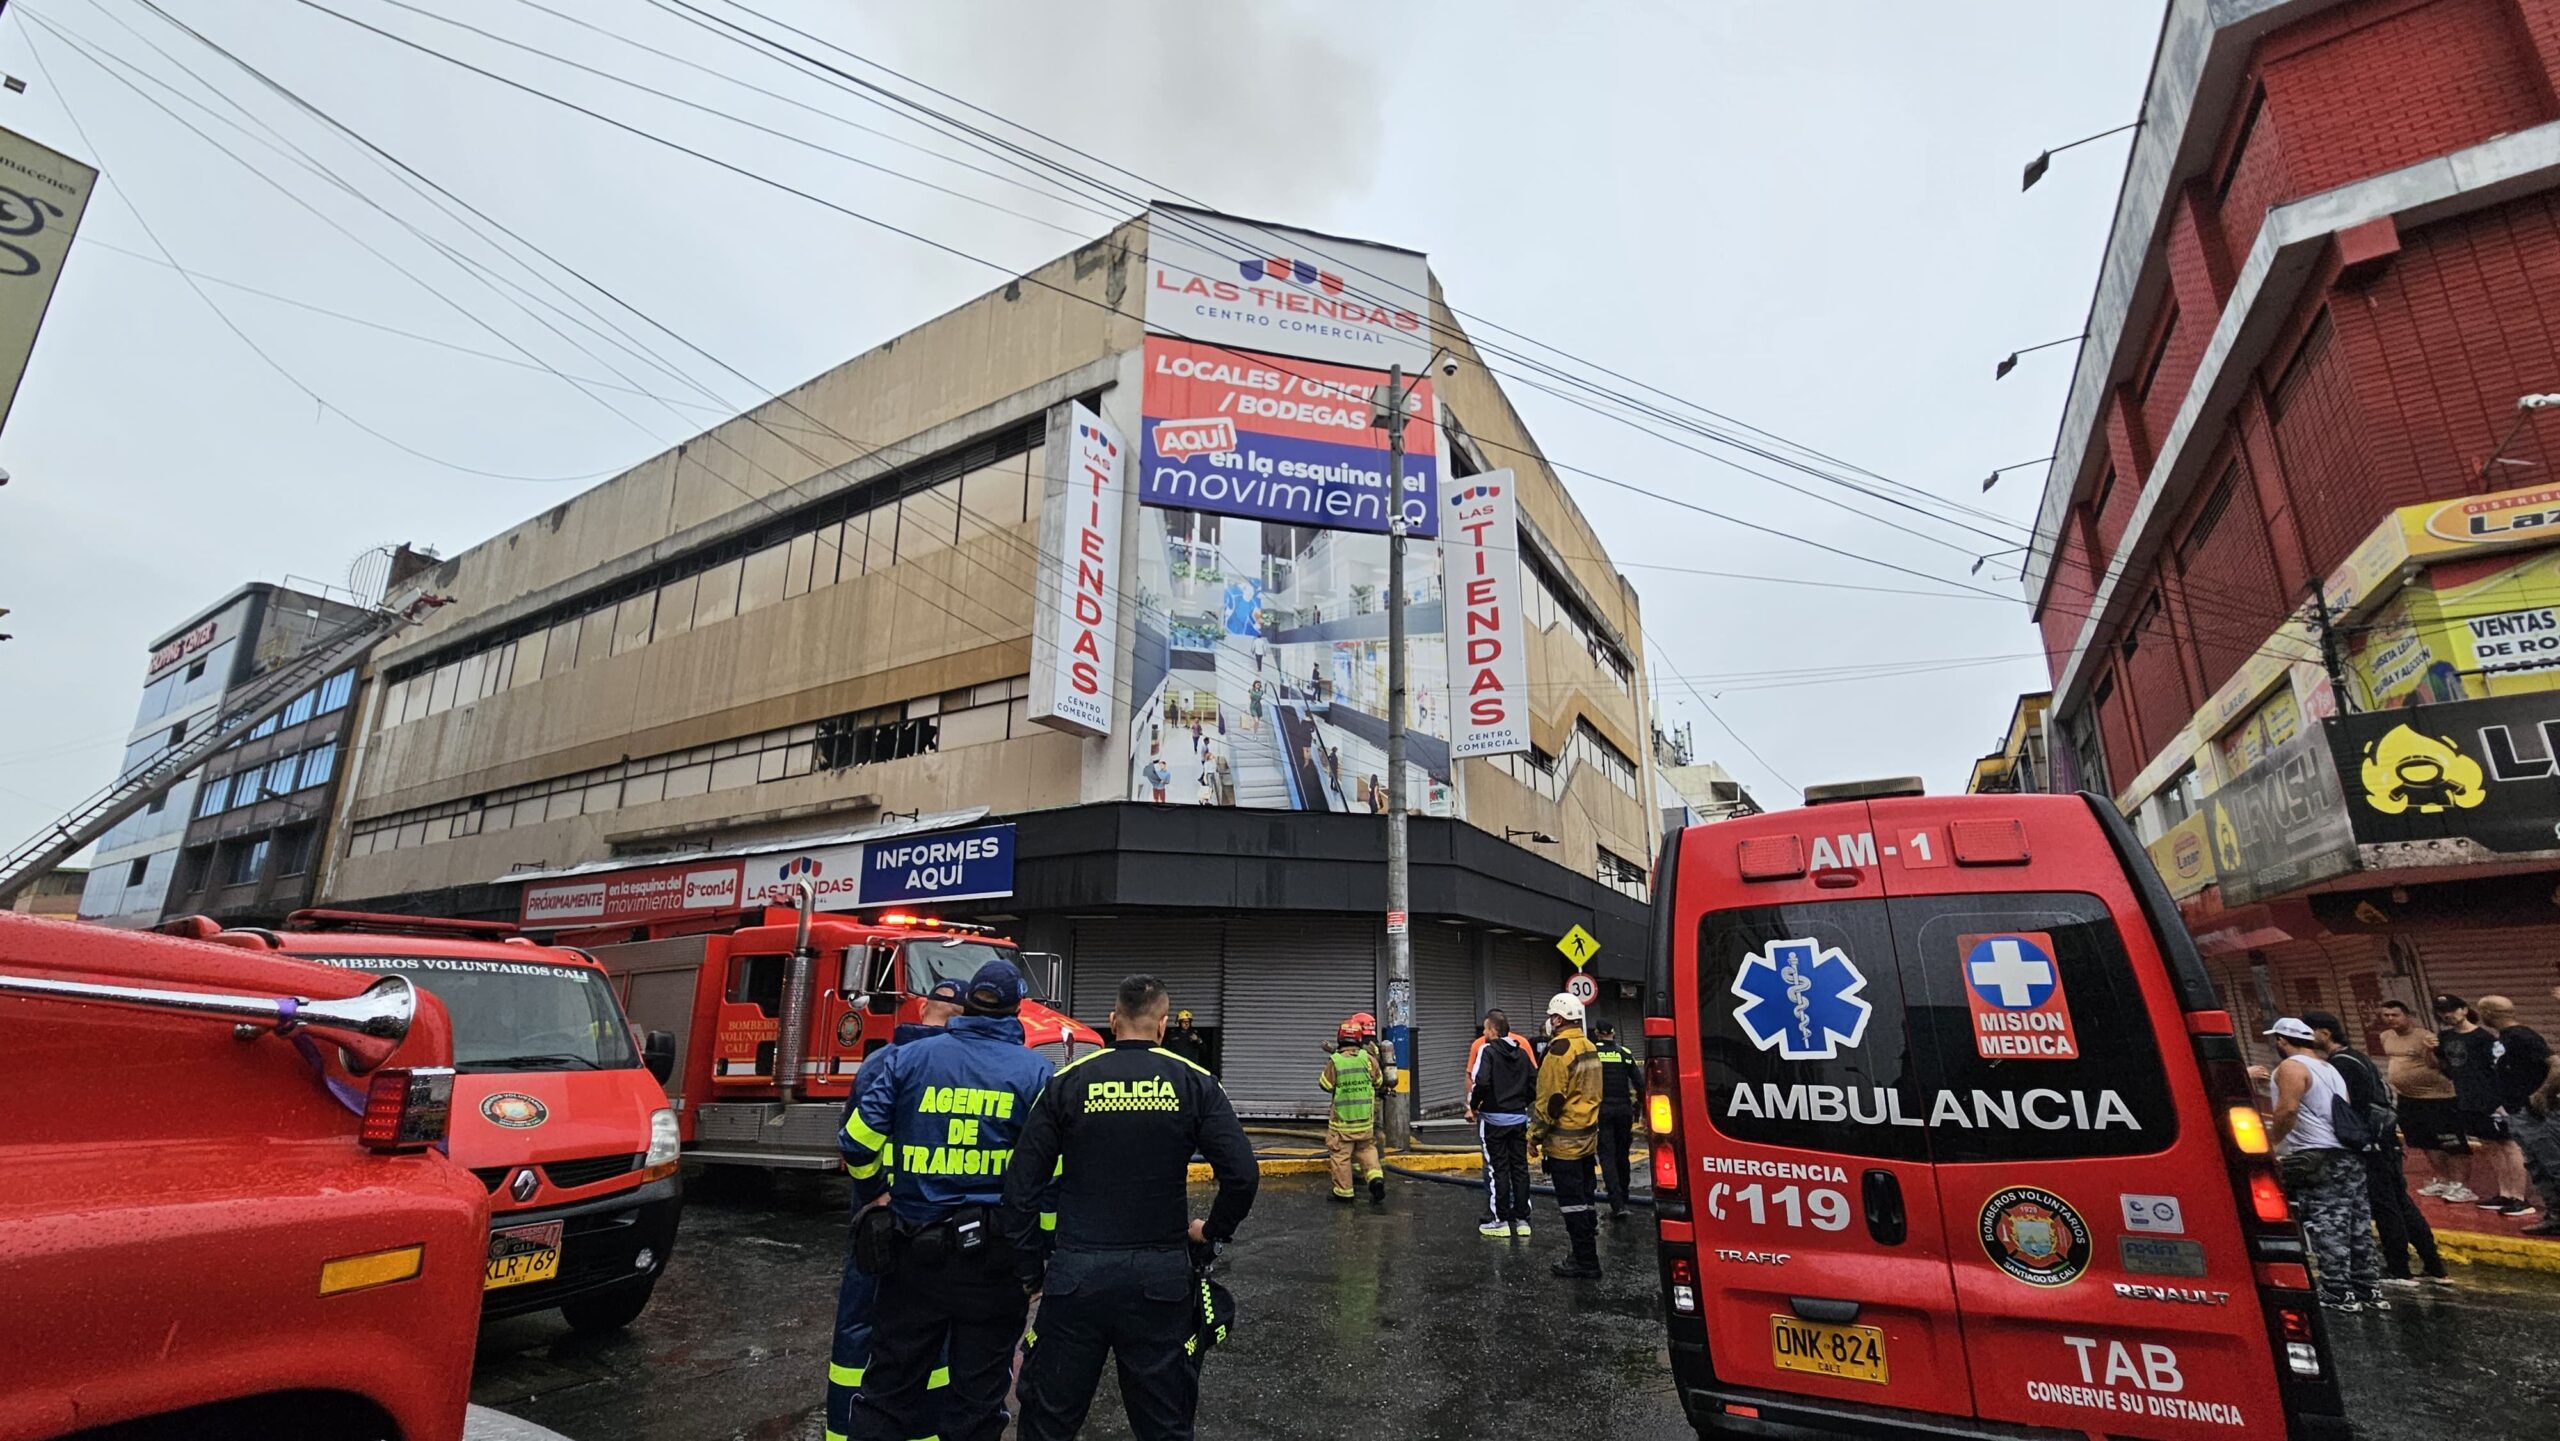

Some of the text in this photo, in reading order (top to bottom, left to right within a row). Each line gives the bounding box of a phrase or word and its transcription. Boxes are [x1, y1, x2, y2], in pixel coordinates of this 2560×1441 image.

[1157, 271, 1420, 332] LAS TIENDAS
[1196, 305, 1384, 345] CENTRO COMERCIAL
[1156, 355, 1281, 392] LOCALES
[1301, 379, 1422, 412] OFICIS
[1237, 394, 1367, 431] BODEGAS
[1162, 424, 1228, 451] AQUÍ
[1084, 446, 1111, 471] LAS
[1209, 452, 1243, 470] en
[1248, 451, 1275, 474] la
[1278, 461, 1382, 487] esquina
[1459, 505, 1494, 520] LAS
[1072, 464, 1110, 695] TIENDAS
[1461, 520, 1505, 726] TIENDAS
[2468, 610, 2557, 638] VENTAS
[2476, 635, 2560, 658] DE RO
[1057, 703, 1106, 727] COMERCIAL
[1068, 695, 1101, 714] CENTRO
[1457, 738, 1520, 752] COMERCIAL
[1469, 729, 1512, 741] CENTRO
[875, 836, 999, 870] INFORMES
[608, 875, 682, 896] en la esquina del
[905, 859, 963, 890] AQUÍ
[528, 891, 604, 911] PRÓXIMAMENTE
[747, 877, 854, 901] LAS TIEDAS
[606, 893, 682, 914] movimiento
[314, 958, 589, 980] OMBEROS VOLUNTARIOS CALI
[1572, 981, 1592, 997] 30
[728, 1020, 781, 1031] BOMBERO
[1979, 1012, 2065, 1031] MISION
[719, 1031, 779, 1041] VOLUNTARI
[724, 1043, 750, 1053] CALI
[1980, 1035, 2075, 1055] MEDICA
[1088, 1075, 1177, 1100] POLICÍA
[918, 1086, 1015, 1119] AGENTE
[1727, 1082, 2143, 1131] AMBULANCIA
[947, 1118, 979, 1145] DE
[1702, 1156, 1849, 1184] EMERGENCIA
[1735, 1183, 1851, 1232] 119
[1983, 1191, 2017, 1242] BOMBEROS
[2017, 1190, 2086, 1245] VOLUNTARIOS
[1714, 1249, 1792, 1265] TRAFIC
[2003, 1261, 2077, 1283] SANTIAGO DE CALI
[2113, 1283, 2230, 1306] RENAULT
[1831, 1332, 1882, 1368] 824
[1818, 1362, 1842, 1374] CALI
[2063, 1335, 2184, 1393] TAB
[2026, 1380, 2245, 1427] CONSERVE SU DISTANCIA
